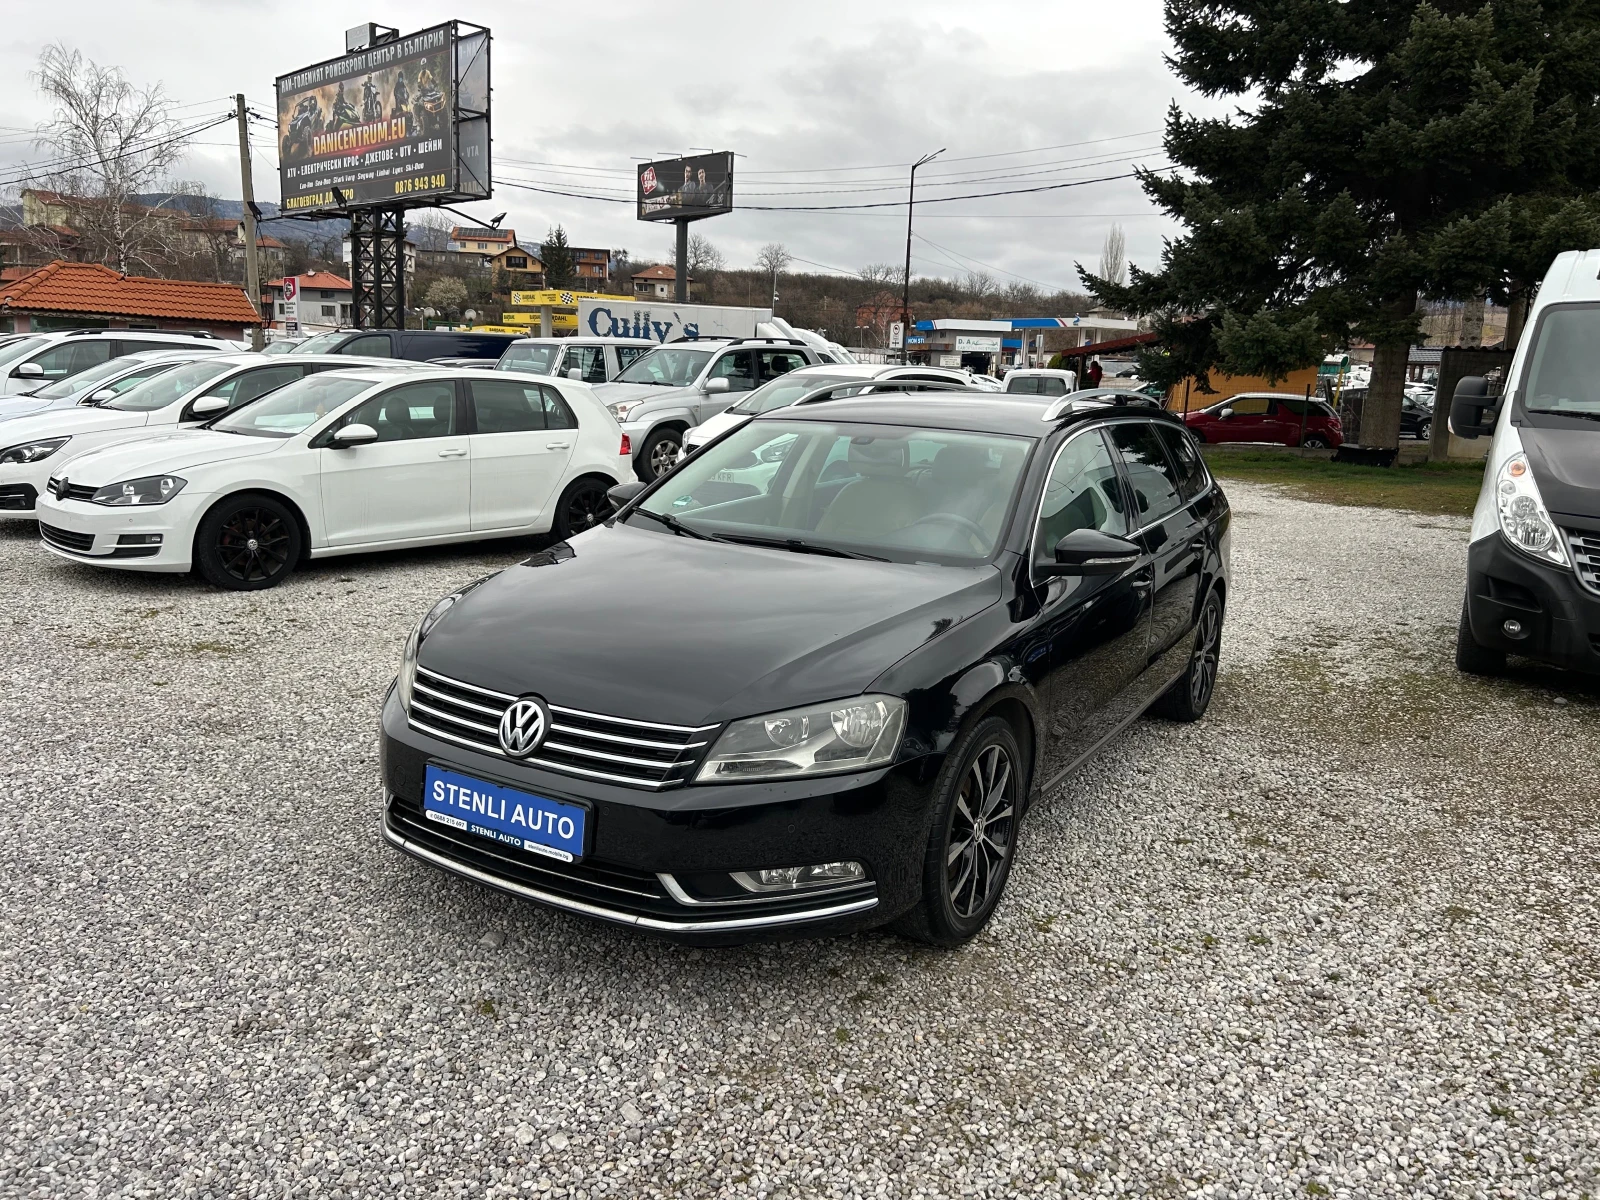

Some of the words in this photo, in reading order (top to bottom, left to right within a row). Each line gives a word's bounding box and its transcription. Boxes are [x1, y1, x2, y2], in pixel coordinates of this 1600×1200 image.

[281, 66, 323, 93] НАЙ-ГОЛЕМИЯТ
[325, 55, 367, 80] POWERSPORT
[368, 46, 395, 69] ЦЕНТЪР
[397, 44, 402, 58] В
[404, 30, 444, 57] БЪЛГАРИЯ
[313, 116, 406, 156] DANICENTRUM.EU
[287, 167, 297, 179] ATV
[301, 158, 342, 176] ЕЛЕКТРИЧЕСКИ
[343, 154, 360, 168] КРОС
[365, 148, 394, 166] ДЖЕТОВЕ
[400, 145, 412, 158] UTV
[418, 138, 442, 154] ШЕЙНИ
[395, 179, 412, 194] 0876
[414, 176, 429, 191] 943
[431, 173, 446, 188] 940
[286, 193, 323, 209] БЛАГОЕВГРАД
[432, 780, 506, 821] STENLI
[510, 803, 575, 839] AUTO
[446, 817, 456, 826] 215
[471, 824, 497, 839] STENLI
[498, 833, 521, 846] AUTO
